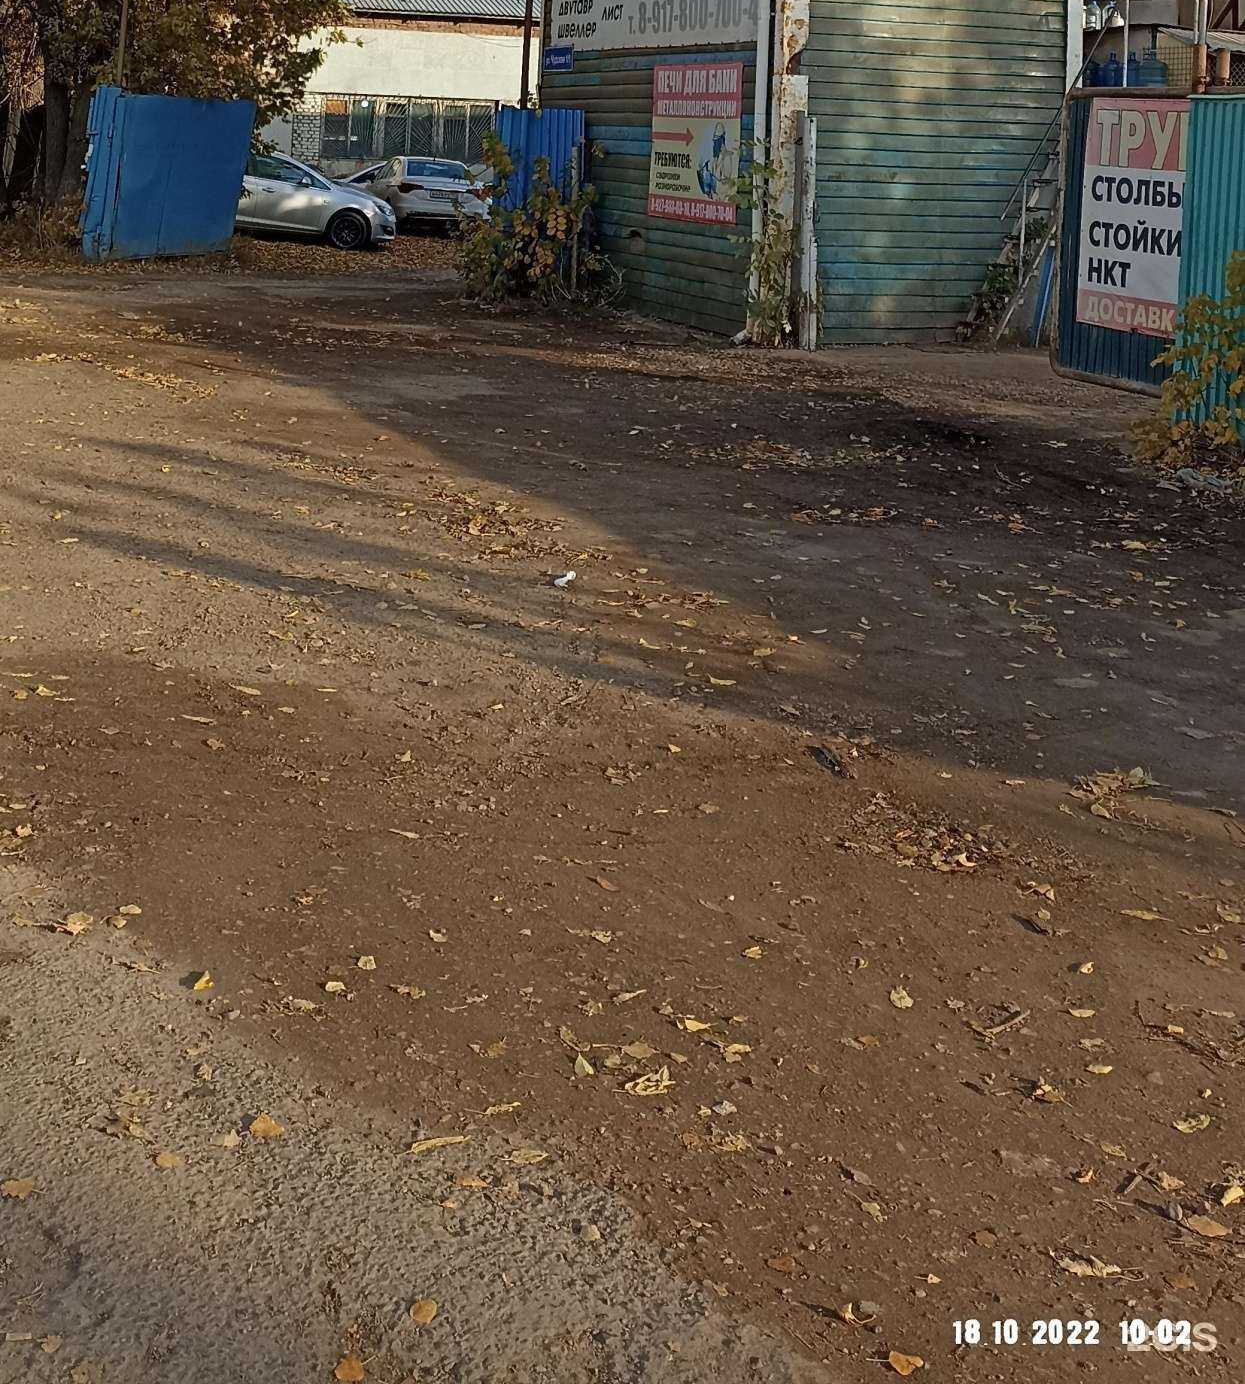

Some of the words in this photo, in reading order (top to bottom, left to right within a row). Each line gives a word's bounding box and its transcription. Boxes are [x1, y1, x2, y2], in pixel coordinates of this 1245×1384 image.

[601, 4, 624, 21] ЛИСТ
[658, 70, 682, 93] ПЕЧИ
[684, 70, 707, 95] ДЛЯ
[708, 68, 738, 94] БАНИ
[654, 151, 692, 169] ТРЕБУЮТСЯ:
[1089, 220, 1183, 258] СТОЙКИ
[1087, 257, 1131, 288] НКТ
